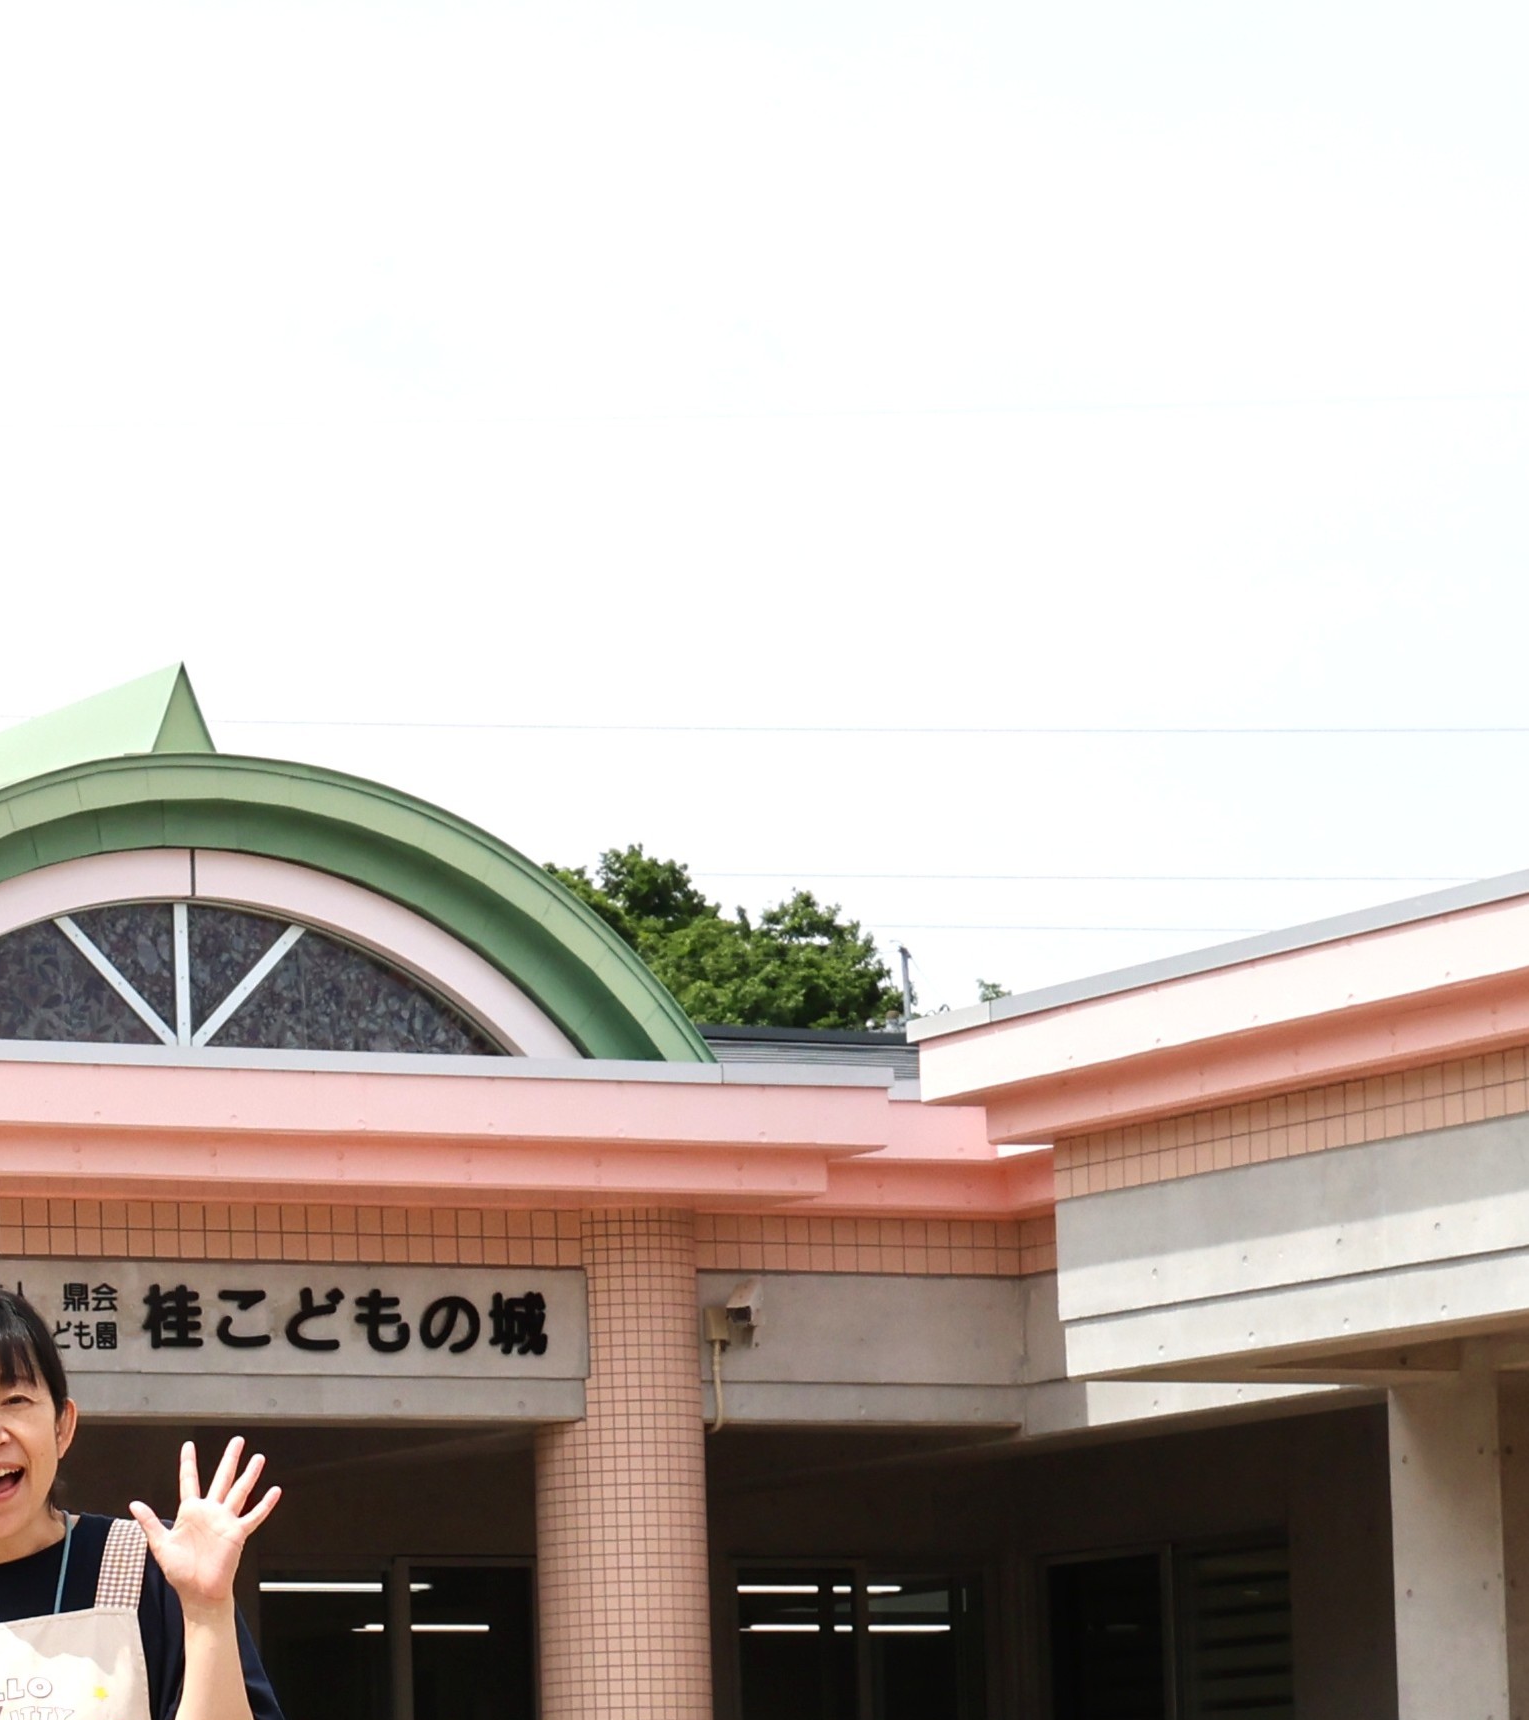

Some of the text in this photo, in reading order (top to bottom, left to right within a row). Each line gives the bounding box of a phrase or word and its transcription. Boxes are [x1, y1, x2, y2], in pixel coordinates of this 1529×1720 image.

[142, 1284, 549, 1355] 桂こどもの城
